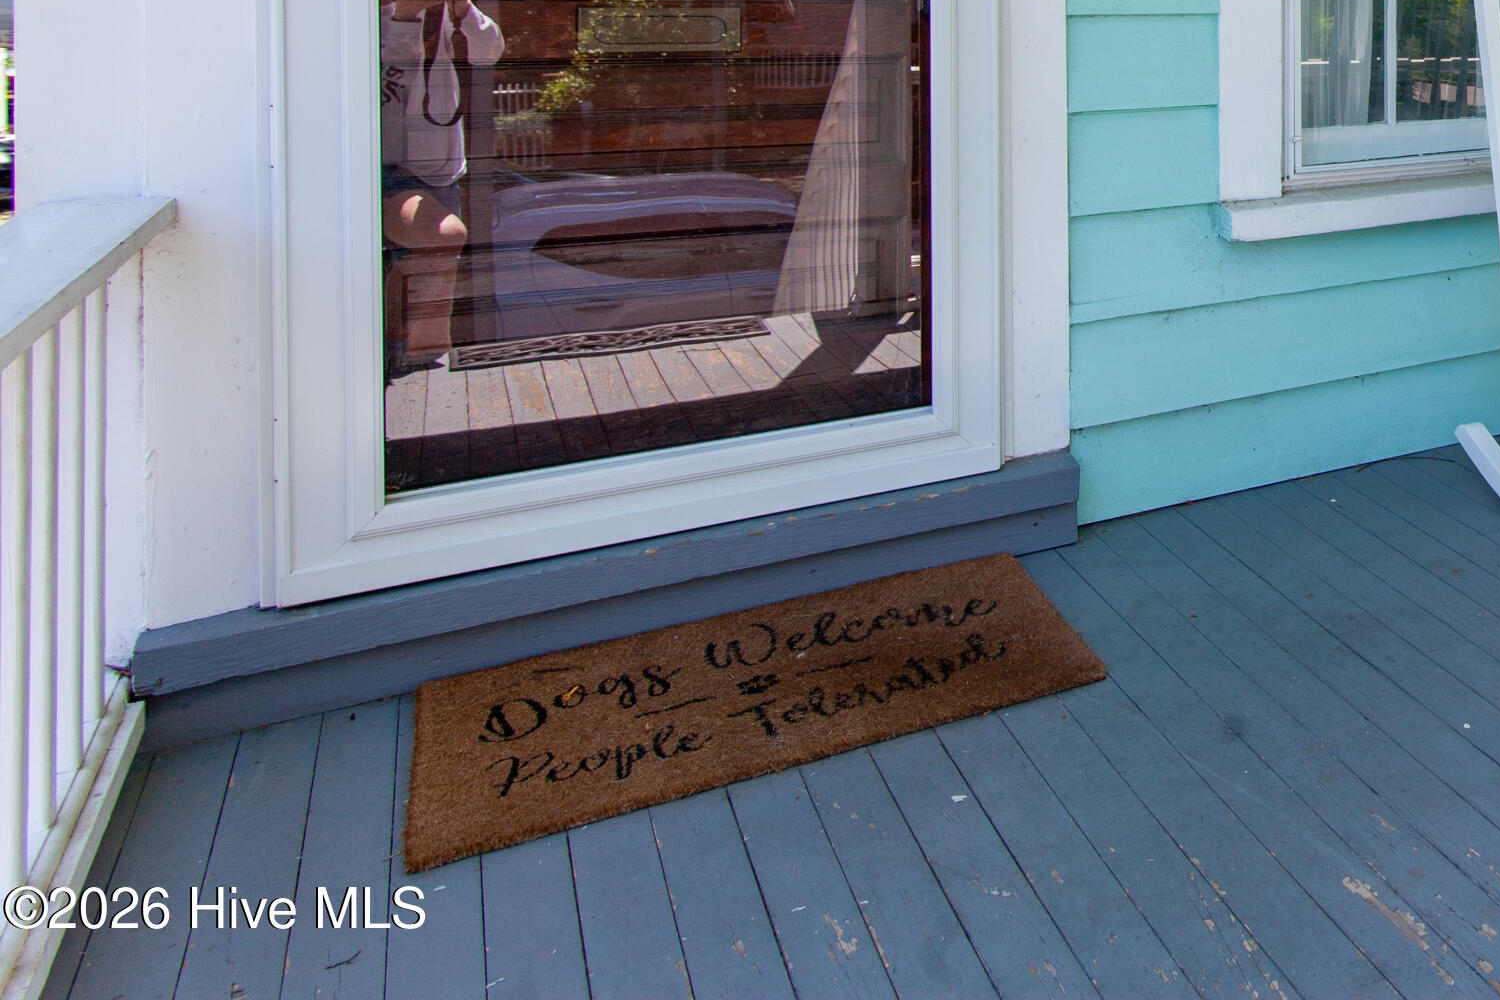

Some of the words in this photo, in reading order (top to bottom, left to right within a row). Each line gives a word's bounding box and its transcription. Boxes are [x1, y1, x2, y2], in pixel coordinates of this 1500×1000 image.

[478, 665, 682, 743] Dogs
[704, 598, 997, 669] Welcome
[484, 724, 714, 799] People
[727, 633, 1007, 737] Tolerated
